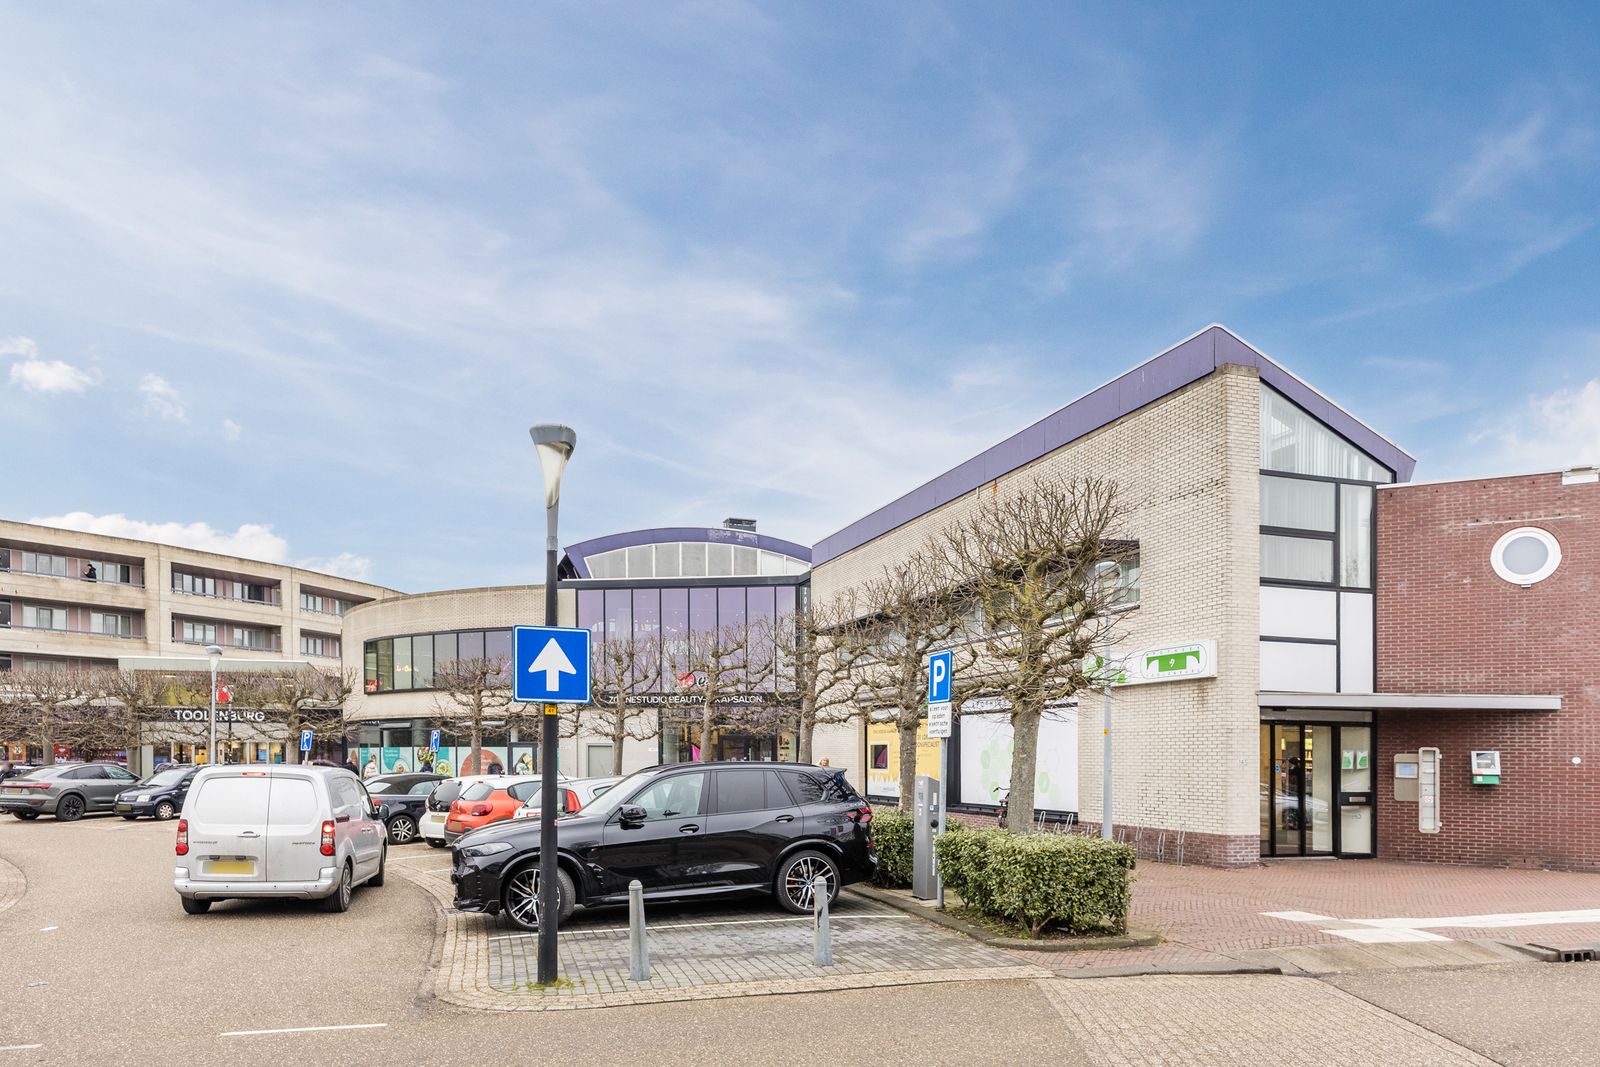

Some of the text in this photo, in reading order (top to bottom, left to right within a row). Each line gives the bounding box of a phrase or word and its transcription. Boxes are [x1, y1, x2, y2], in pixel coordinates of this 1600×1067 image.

[933, 659, 945, 697] P
[609, 694, 668, 704] ZONESTUDIO
[304, 732, 311, 743] P
[433, 732, 438, 743] P
